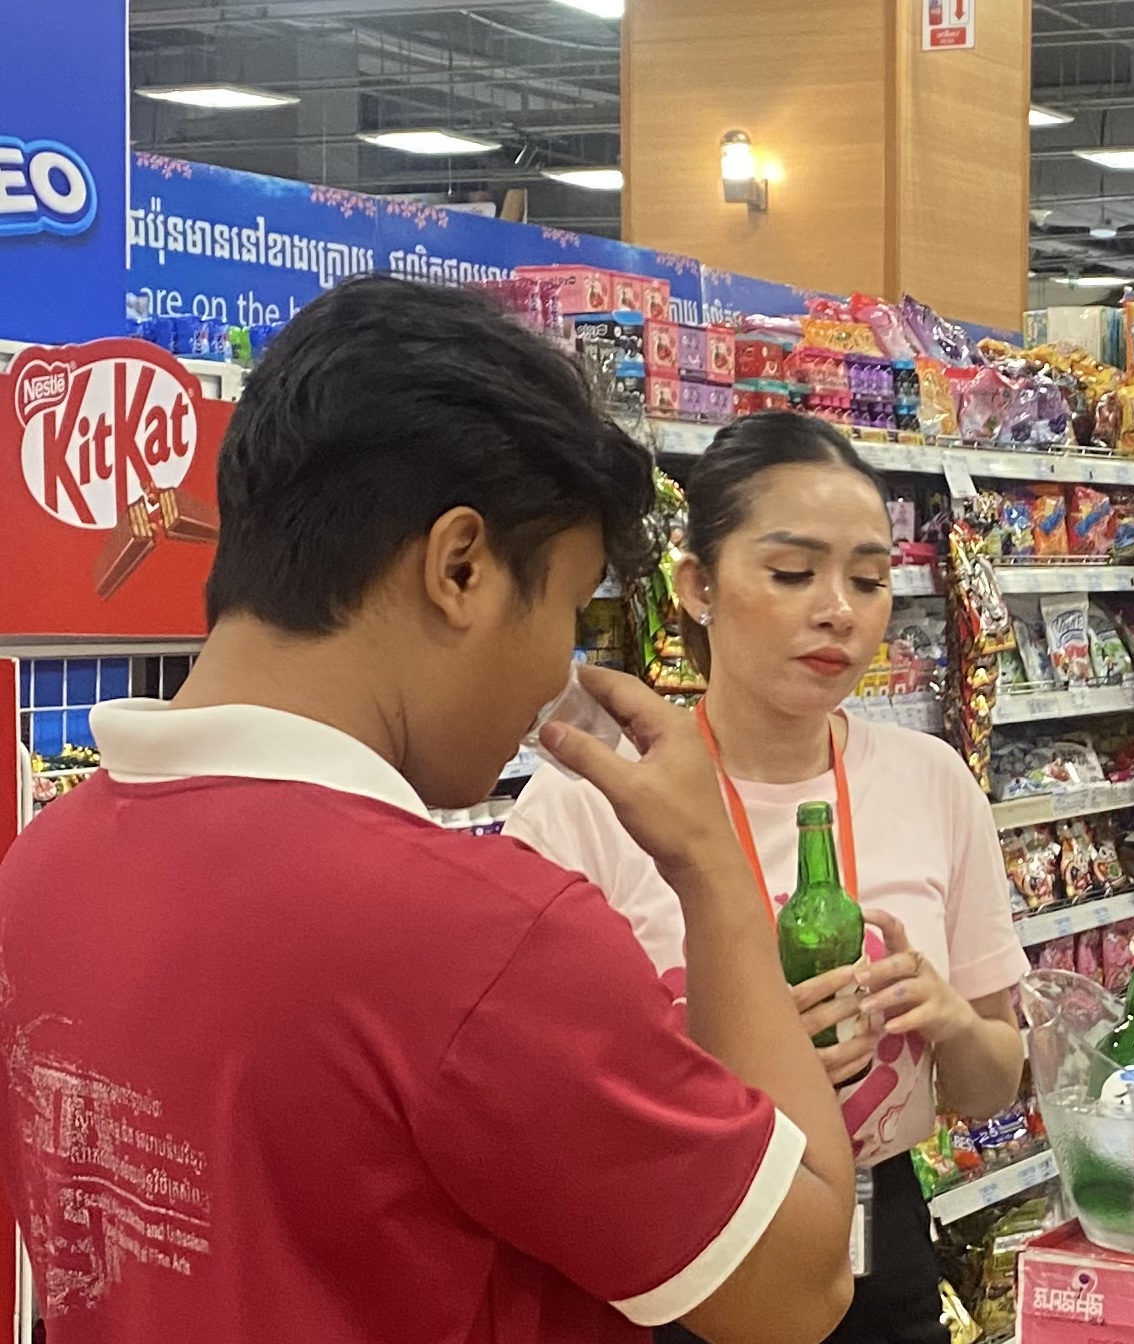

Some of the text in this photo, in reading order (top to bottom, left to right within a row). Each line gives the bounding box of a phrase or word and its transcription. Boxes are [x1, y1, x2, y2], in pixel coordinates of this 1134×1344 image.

[192, 294, 227, 321] on
[237, 291, 280, 326] the
[43, 361, 191, 526] KitKat
